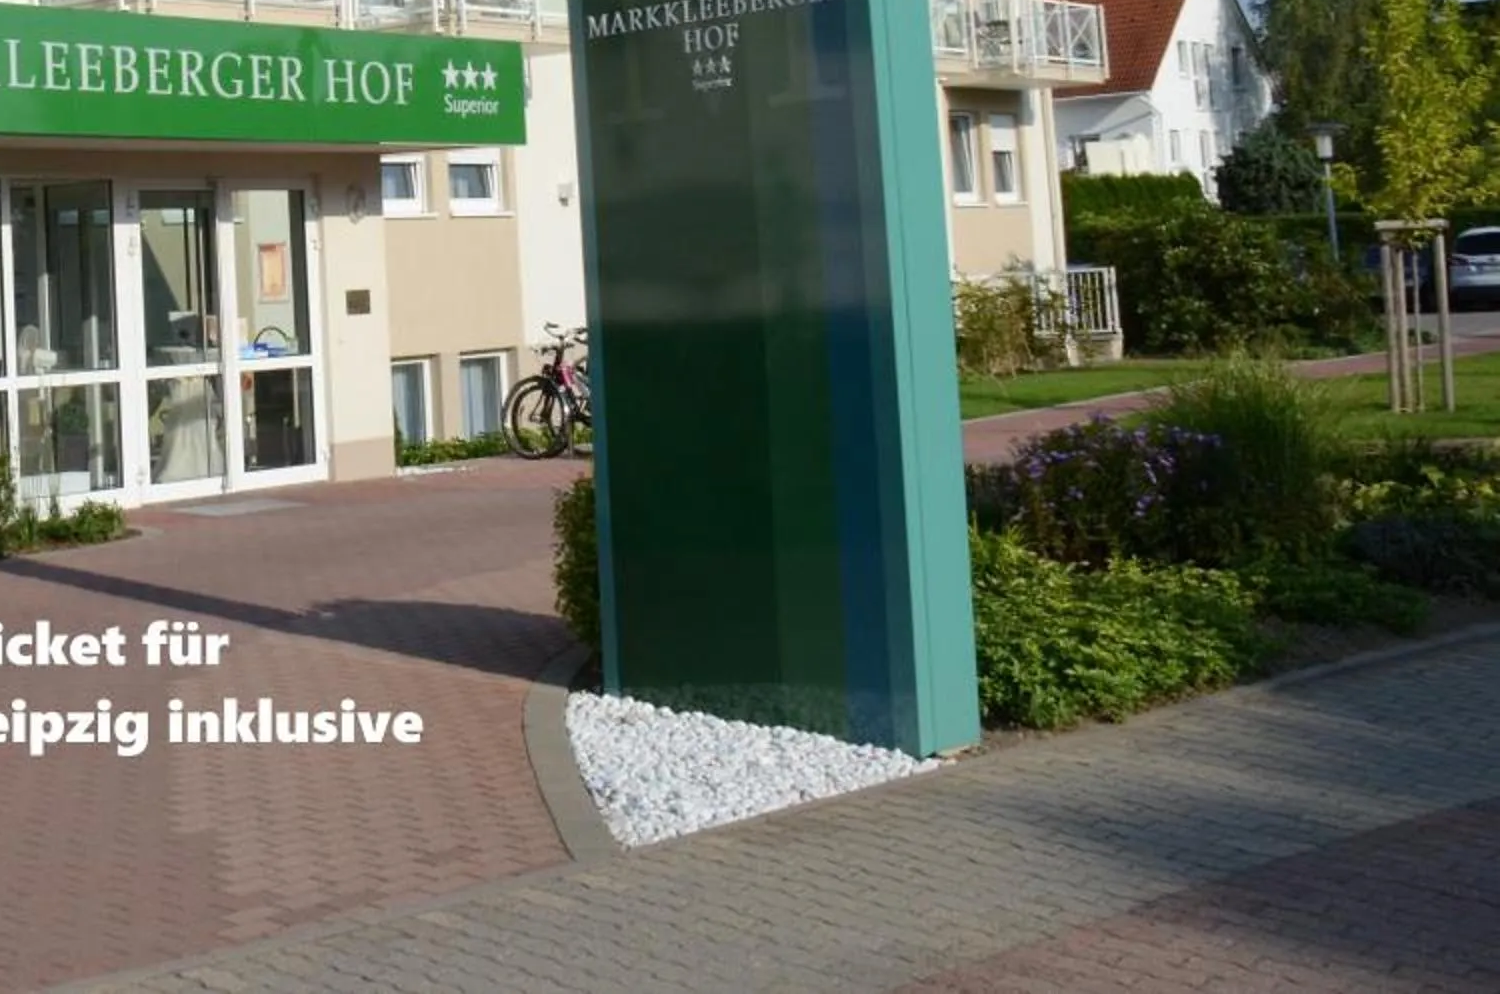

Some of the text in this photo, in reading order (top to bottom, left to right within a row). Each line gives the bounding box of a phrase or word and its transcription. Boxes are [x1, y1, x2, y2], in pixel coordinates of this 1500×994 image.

[683, 23, 740, 54] HOF
[324, 59, 414, 105] HOF
[443, 93, 499, 118] Superior
